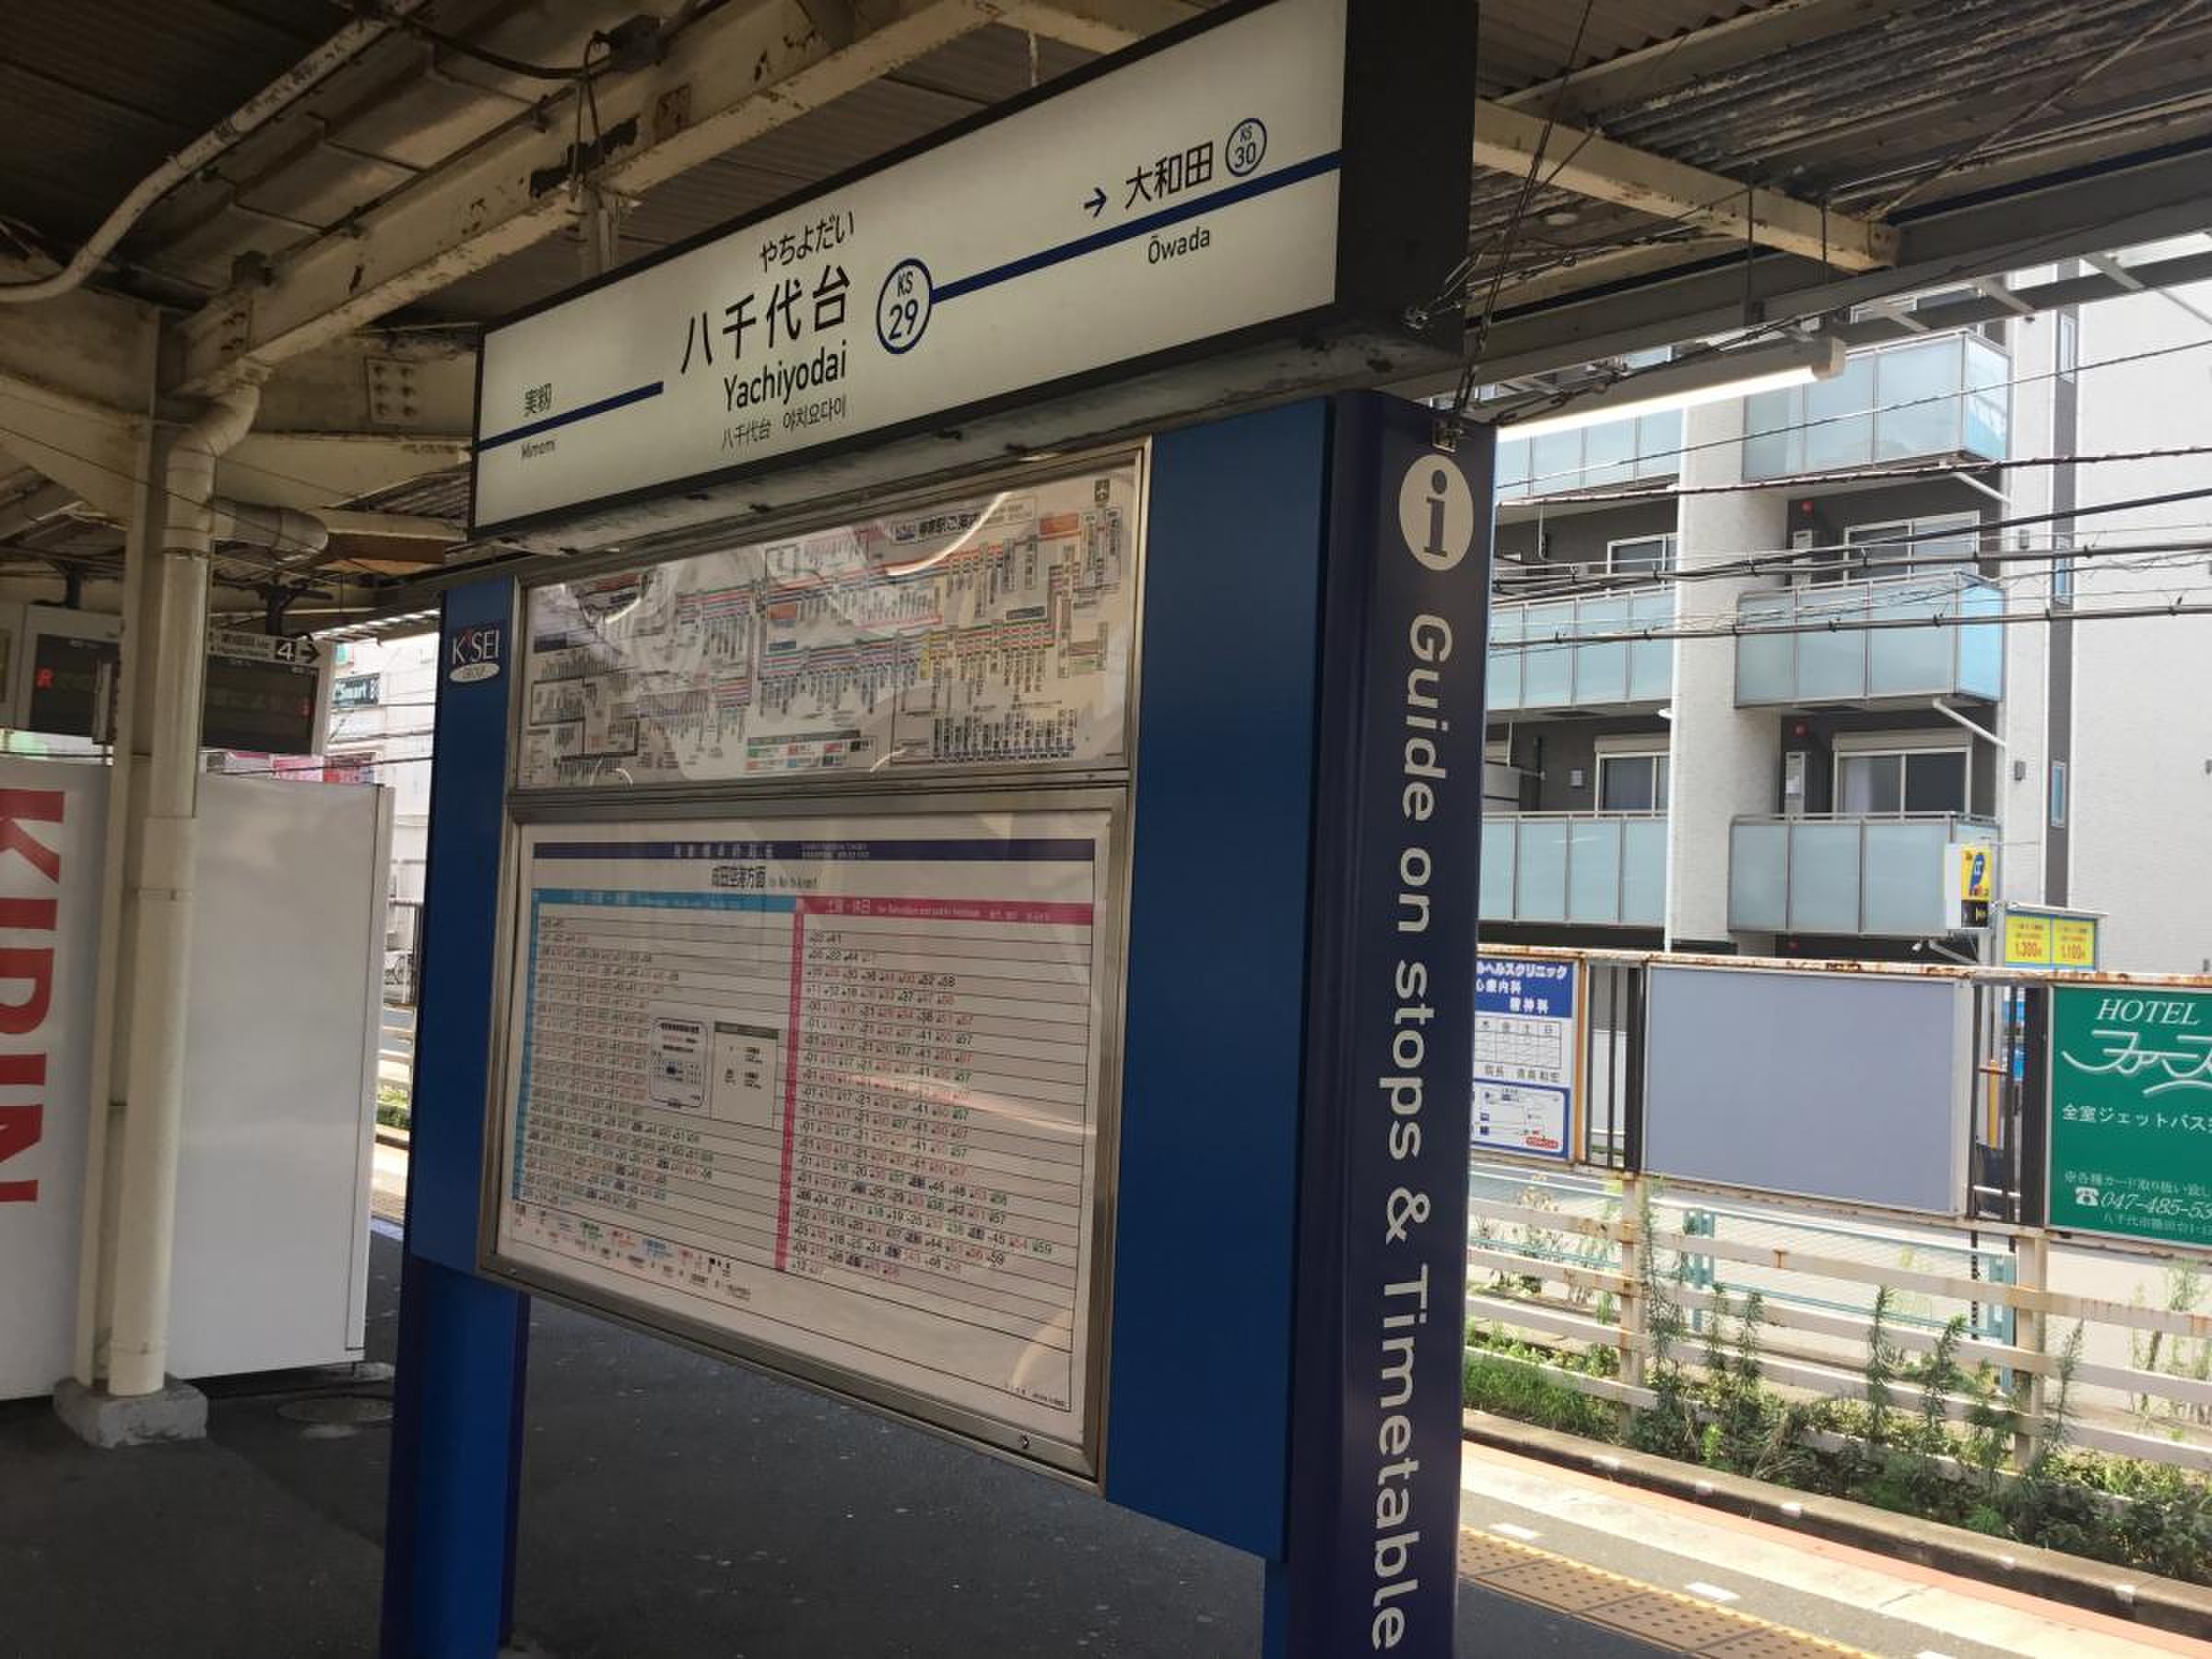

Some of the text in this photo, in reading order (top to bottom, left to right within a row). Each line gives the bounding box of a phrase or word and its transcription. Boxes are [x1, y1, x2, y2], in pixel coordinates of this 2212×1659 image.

[1125, 141, 1214, 209] 大和田
[1234, 142, 1256, 169] 30
[759, 210, 855, 273] やちよだい
[1147, 227, 1210, 265] Ōwada
[897, 271, 914, 298] KS
[681, 265, 851, 375] 八千代台
[888, 299, 919, 341] 29
[724, 339, 847, 412] Yachiyodai
[722, 395, 846, 450] 八千代台 야치요다이
[277, 641, 295, 661] 4
[2096, 998, 2200, 1025] HOTEL
[1371, 614, 1453, 1651] Guide on stops & Timetable
[2062, 1103, 2212, 1133] 全室ジェットバス
